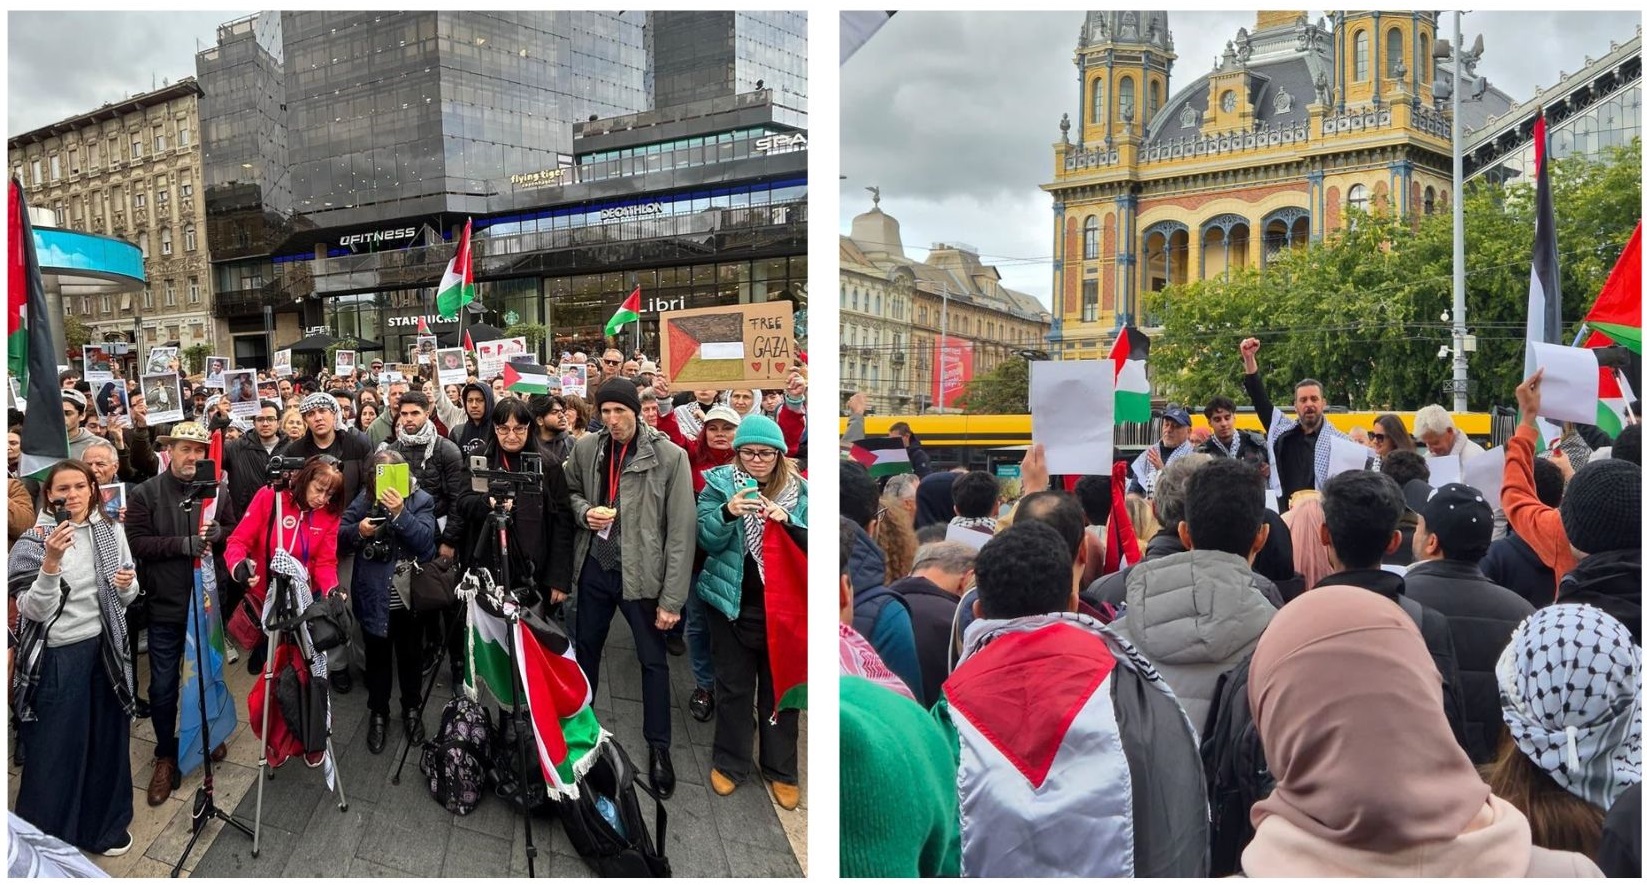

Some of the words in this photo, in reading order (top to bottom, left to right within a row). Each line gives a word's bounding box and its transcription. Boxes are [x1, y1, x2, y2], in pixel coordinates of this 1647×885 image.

[511, 173, 539, 184] flying
[540, 169, 566, 179] tiger
[601, 202, 663, 219] DECATHLON
[749, 316, 783, 330] FREE
[753, 335, 790, 358] GAZA
